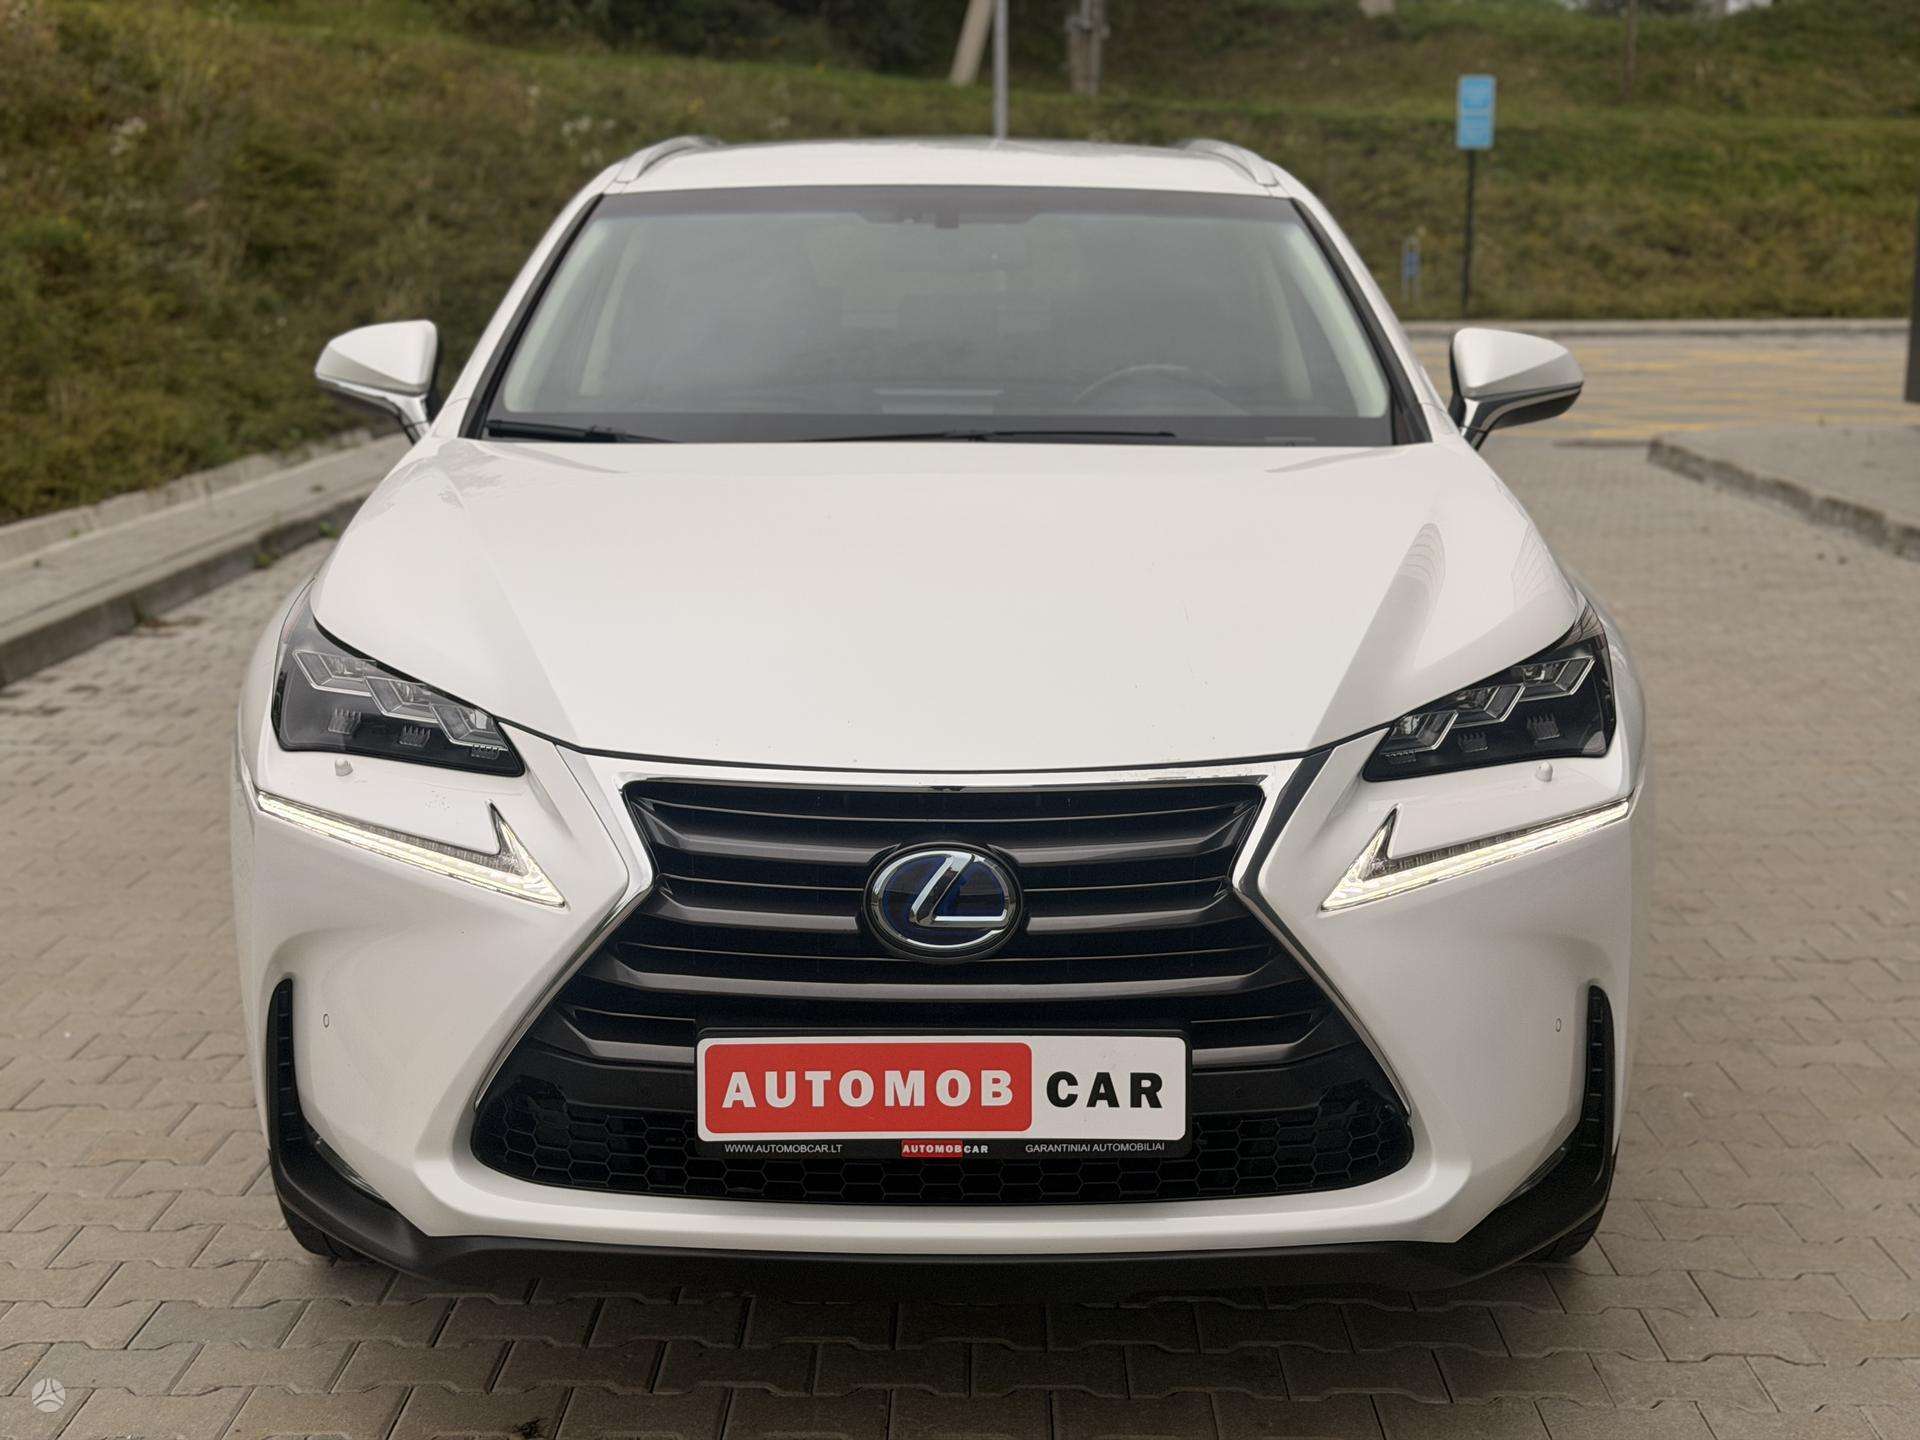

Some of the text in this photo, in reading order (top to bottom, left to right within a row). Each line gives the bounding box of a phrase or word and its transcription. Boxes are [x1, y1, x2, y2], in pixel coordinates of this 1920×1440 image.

[721, 1069, 1164, 1109] AUTOMOB CAR
[724, 1143, 843, 1154] WWW.AUTOMOBCAR.LT
[1025, 1142, 1165, 1153] GARANTINIAI AUTOMOBILIAI
